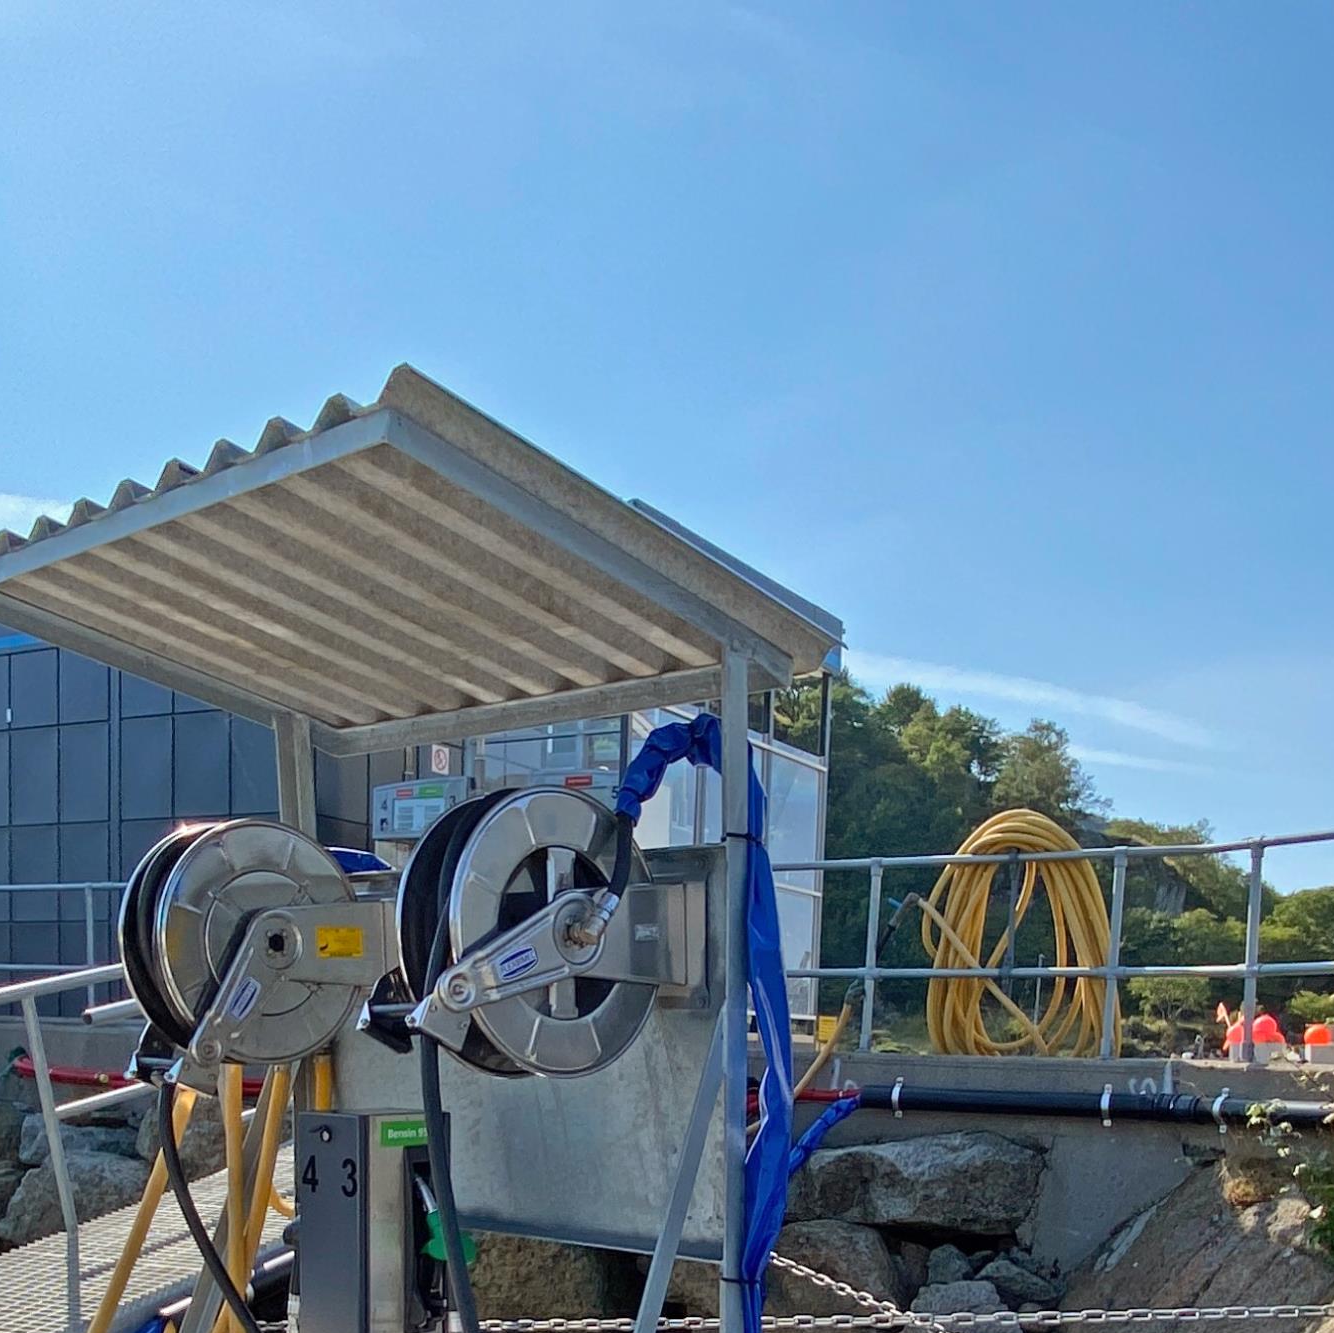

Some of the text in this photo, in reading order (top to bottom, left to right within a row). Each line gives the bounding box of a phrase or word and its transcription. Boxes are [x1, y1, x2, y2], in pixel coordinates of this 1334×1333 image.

[380, 799, 388, 811] 4
[388, 1128, 416, 1139] Bensin
[302, 1155, 357, 1198] 4 3
